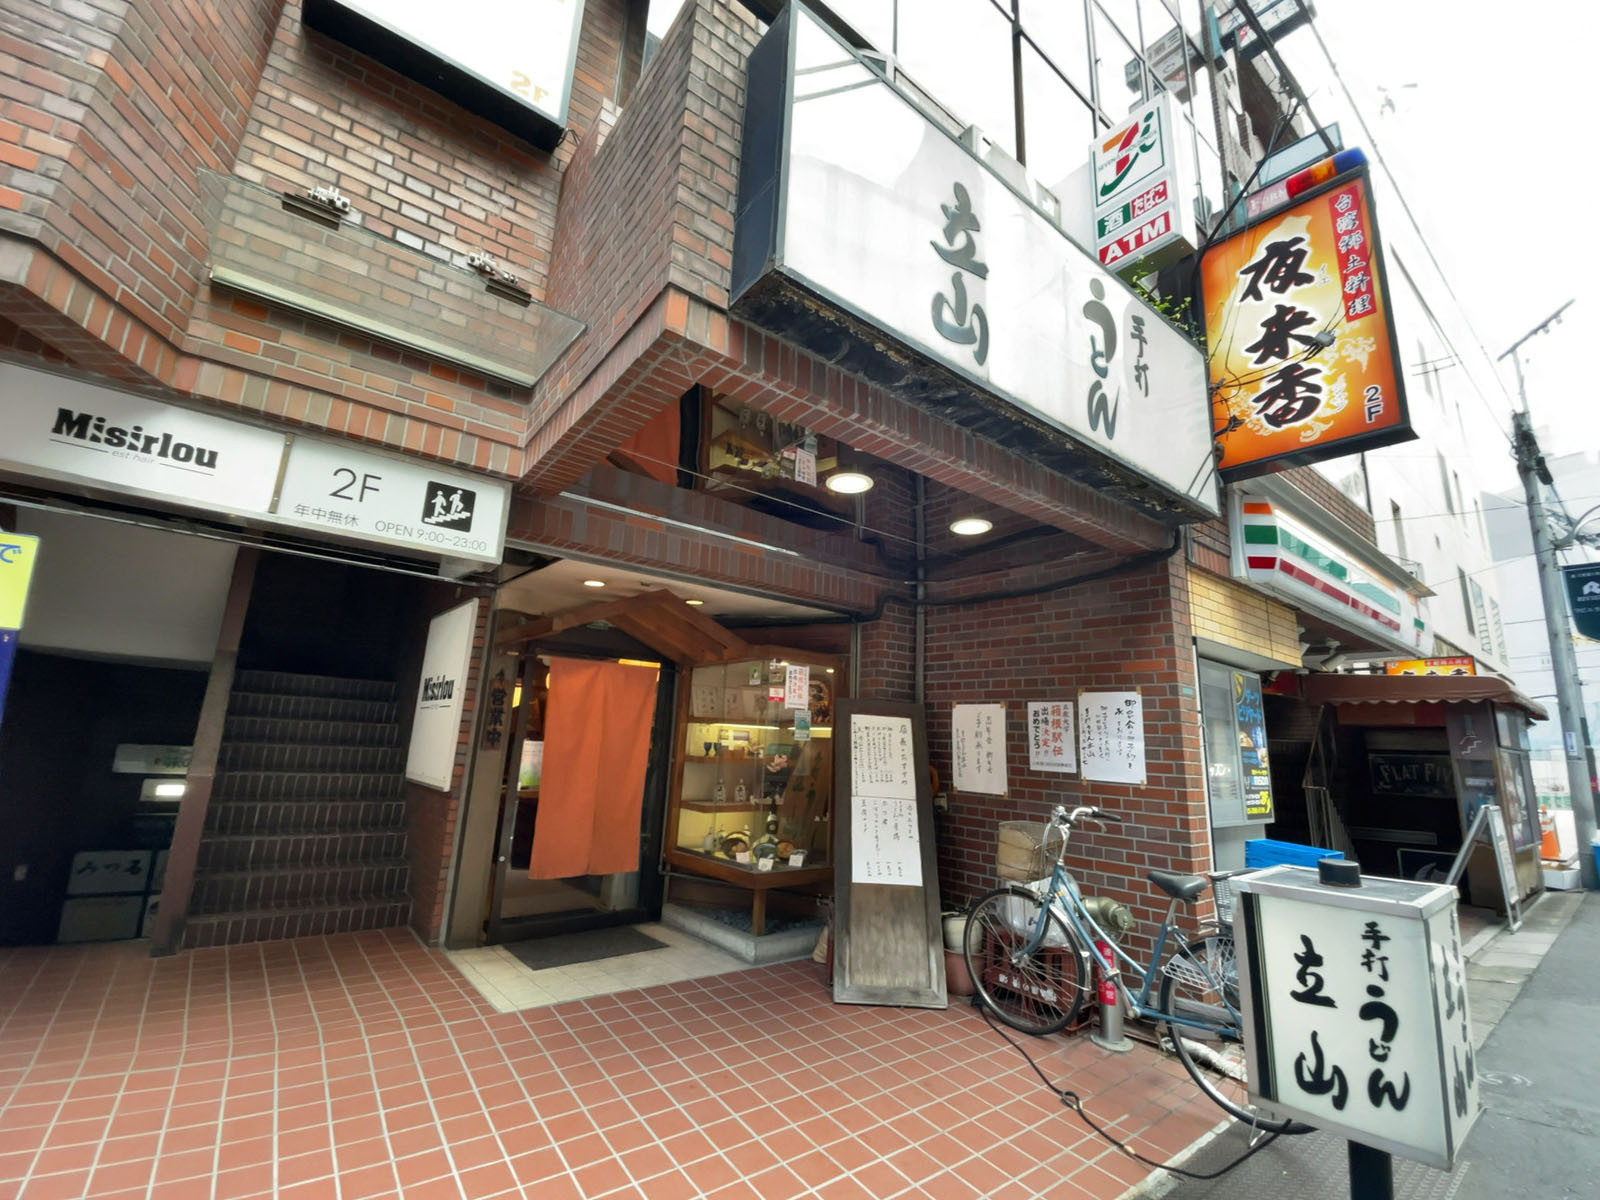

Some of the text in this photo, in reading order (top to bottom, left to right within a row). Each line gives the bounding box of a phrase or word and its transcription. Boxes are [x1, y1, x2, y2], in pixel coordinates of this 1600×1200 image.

[1103, 186, 1166, 235] 酒 たばこ
[1103, 215, 1167, 266] ATM
[1130, 314, 1150, 398] 手打
[1363, 383, 1384, 424] 2F
[51, 407, 219, 469] Misirlou
[328, 467, 382, 503] 2F
[293, 503, 360, 528] 年中無休
[374, 519, 414, 538] OPEN
[1289, 934, 1350, 1112] 立山
[1358, 920, 1412, 1112] 手打うどん
